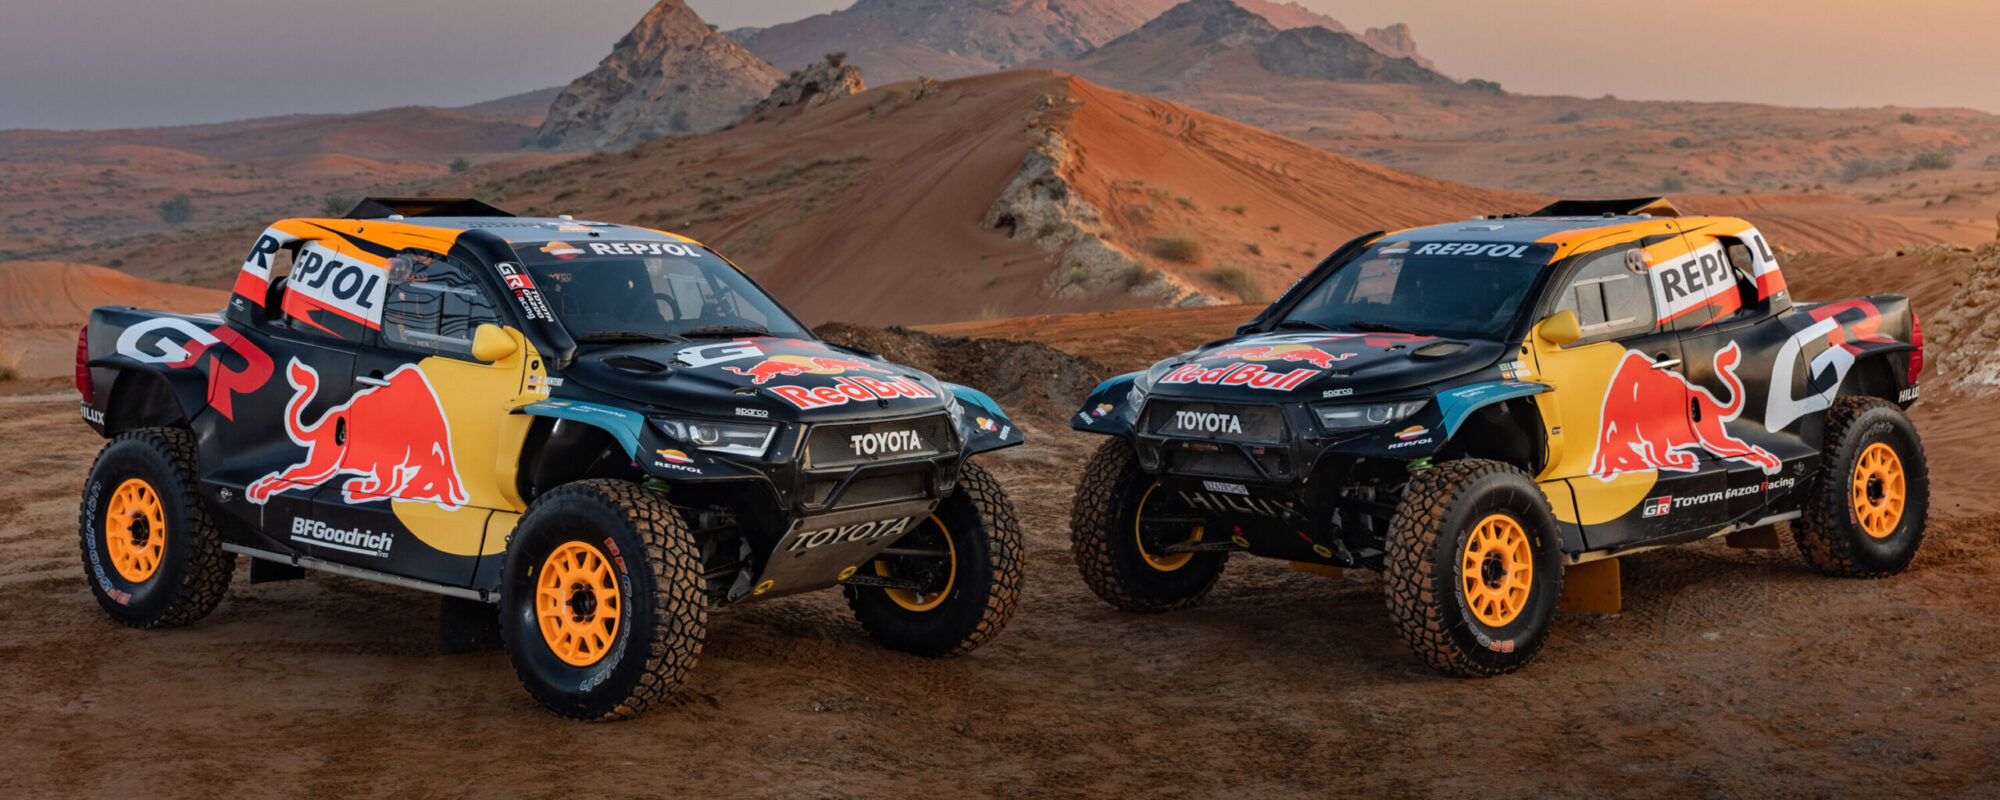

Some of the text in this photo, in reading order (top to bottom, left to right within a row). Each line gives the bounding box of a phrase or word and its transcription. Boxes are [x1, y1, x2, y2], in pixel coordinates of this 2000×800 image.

[589, 242, 702, 257] REPSOL
[1414, 243, 1529, 258] REPSOL
[498, 263, 524, 288] GR
[513, 289, 536, 320] Racing
[522, 289, 545, 319] GAZOO
[531, 290, 554, 322] TOYOTA
[116, 317, 275, 422] GR
[1765, 299, 1899, 434] GR
[1322, 387, 1354, 398] sparco
[735, 407, 769, 418] sparco
[1176, 410, 1242, 434] TOYOTA
[851, 430, 922, 455] TOYOTA
[1387, 437, 1433, 450] REPSOL
[654, 460, 703, 474] REPSOL
[1644, 503, 1670, 516] GR
[1674, 491, 1723, 508] TOYOTA
[1761, 477, 1795, 492] Racing
[291, 516, 394, 551] BFGoodrich
[788, 516, 911, 552] TOYOTA
